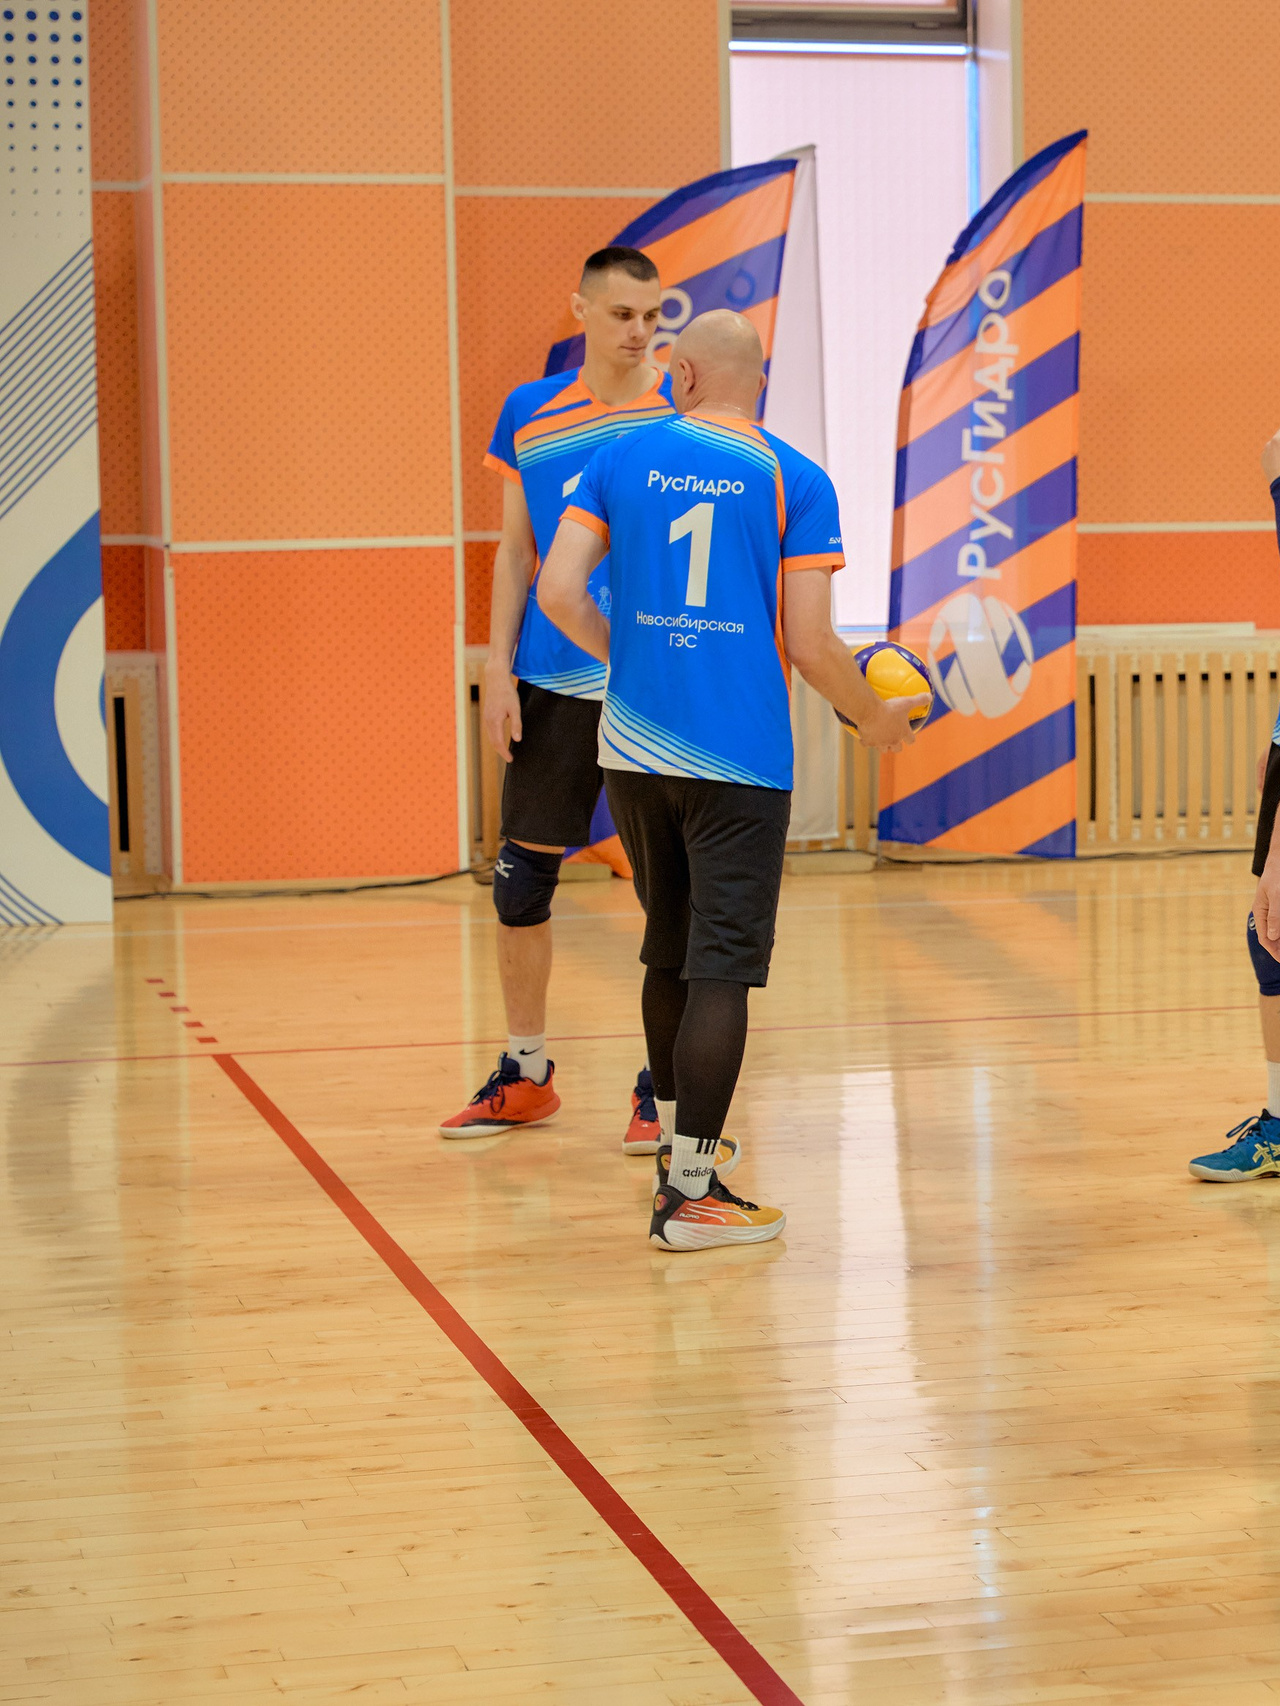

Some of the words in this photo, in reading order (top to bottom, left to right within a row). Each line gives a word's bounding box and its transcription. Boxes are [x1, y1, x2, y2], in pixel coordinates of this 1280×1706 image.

[647, 469, 745, 497] РусГидро
[668, 502, 715, 608] 1
[635, 610, 745, 634] Новосибирская
[668, 633, 699, 649] ГЭС
[682, 1166, 714, 1178] adida
